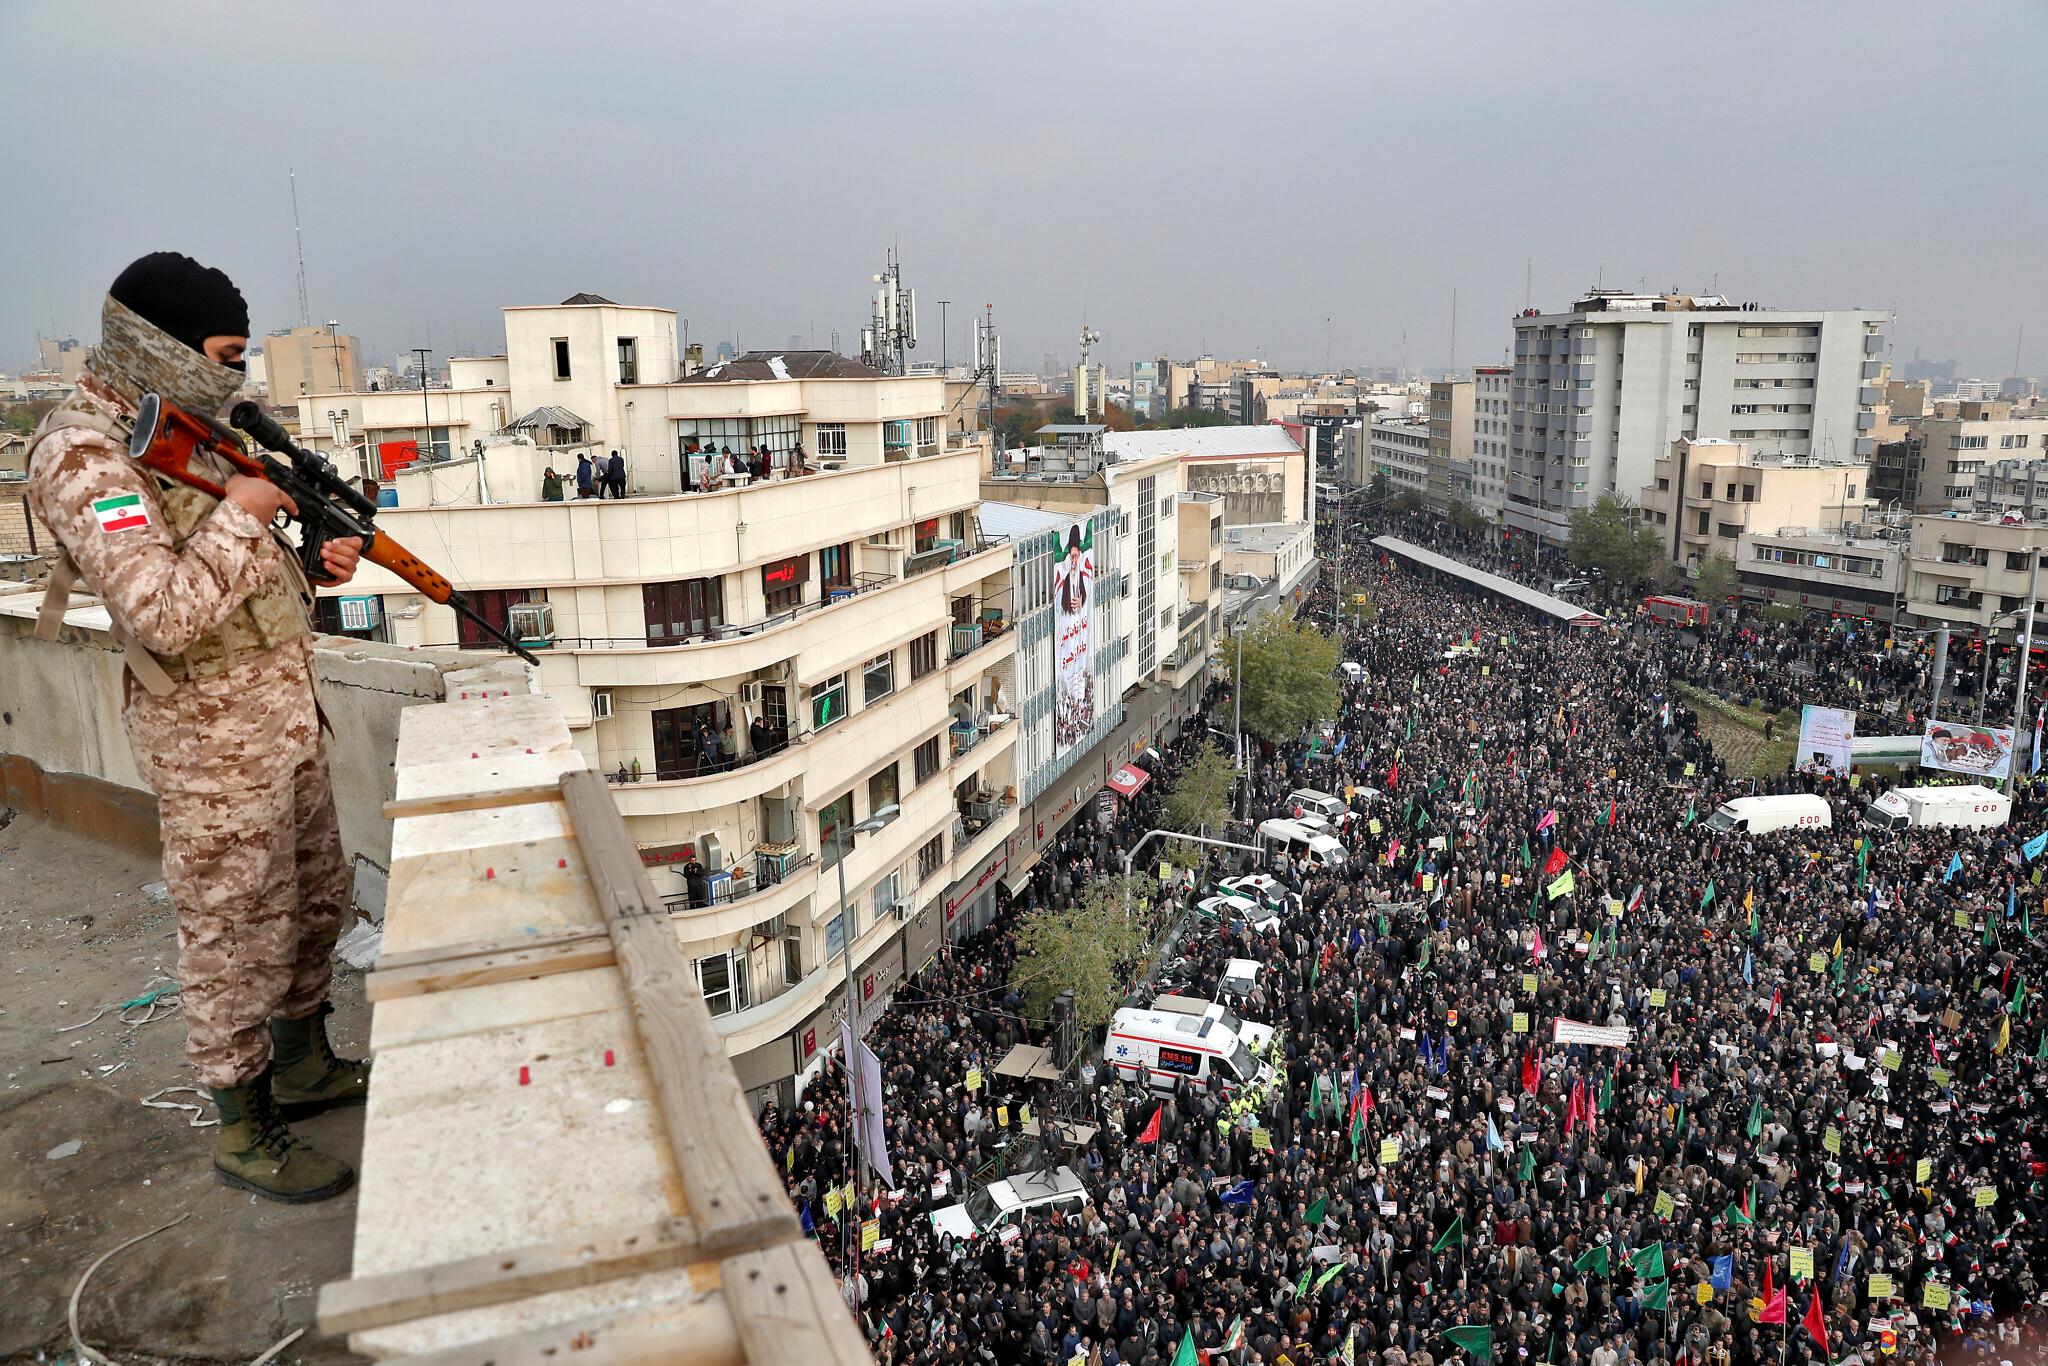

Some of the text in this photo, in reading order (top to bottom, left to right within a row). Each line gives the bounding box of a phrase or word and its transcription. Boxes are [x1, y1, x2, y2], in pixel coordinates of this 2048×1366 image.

[1884, 794, 1898, 804] EOD
[1974, 804, 1997, 813] EOD
[1800, 815, 1820, 825] EOD
[1161, 1051, 1179, 1060] EMS
